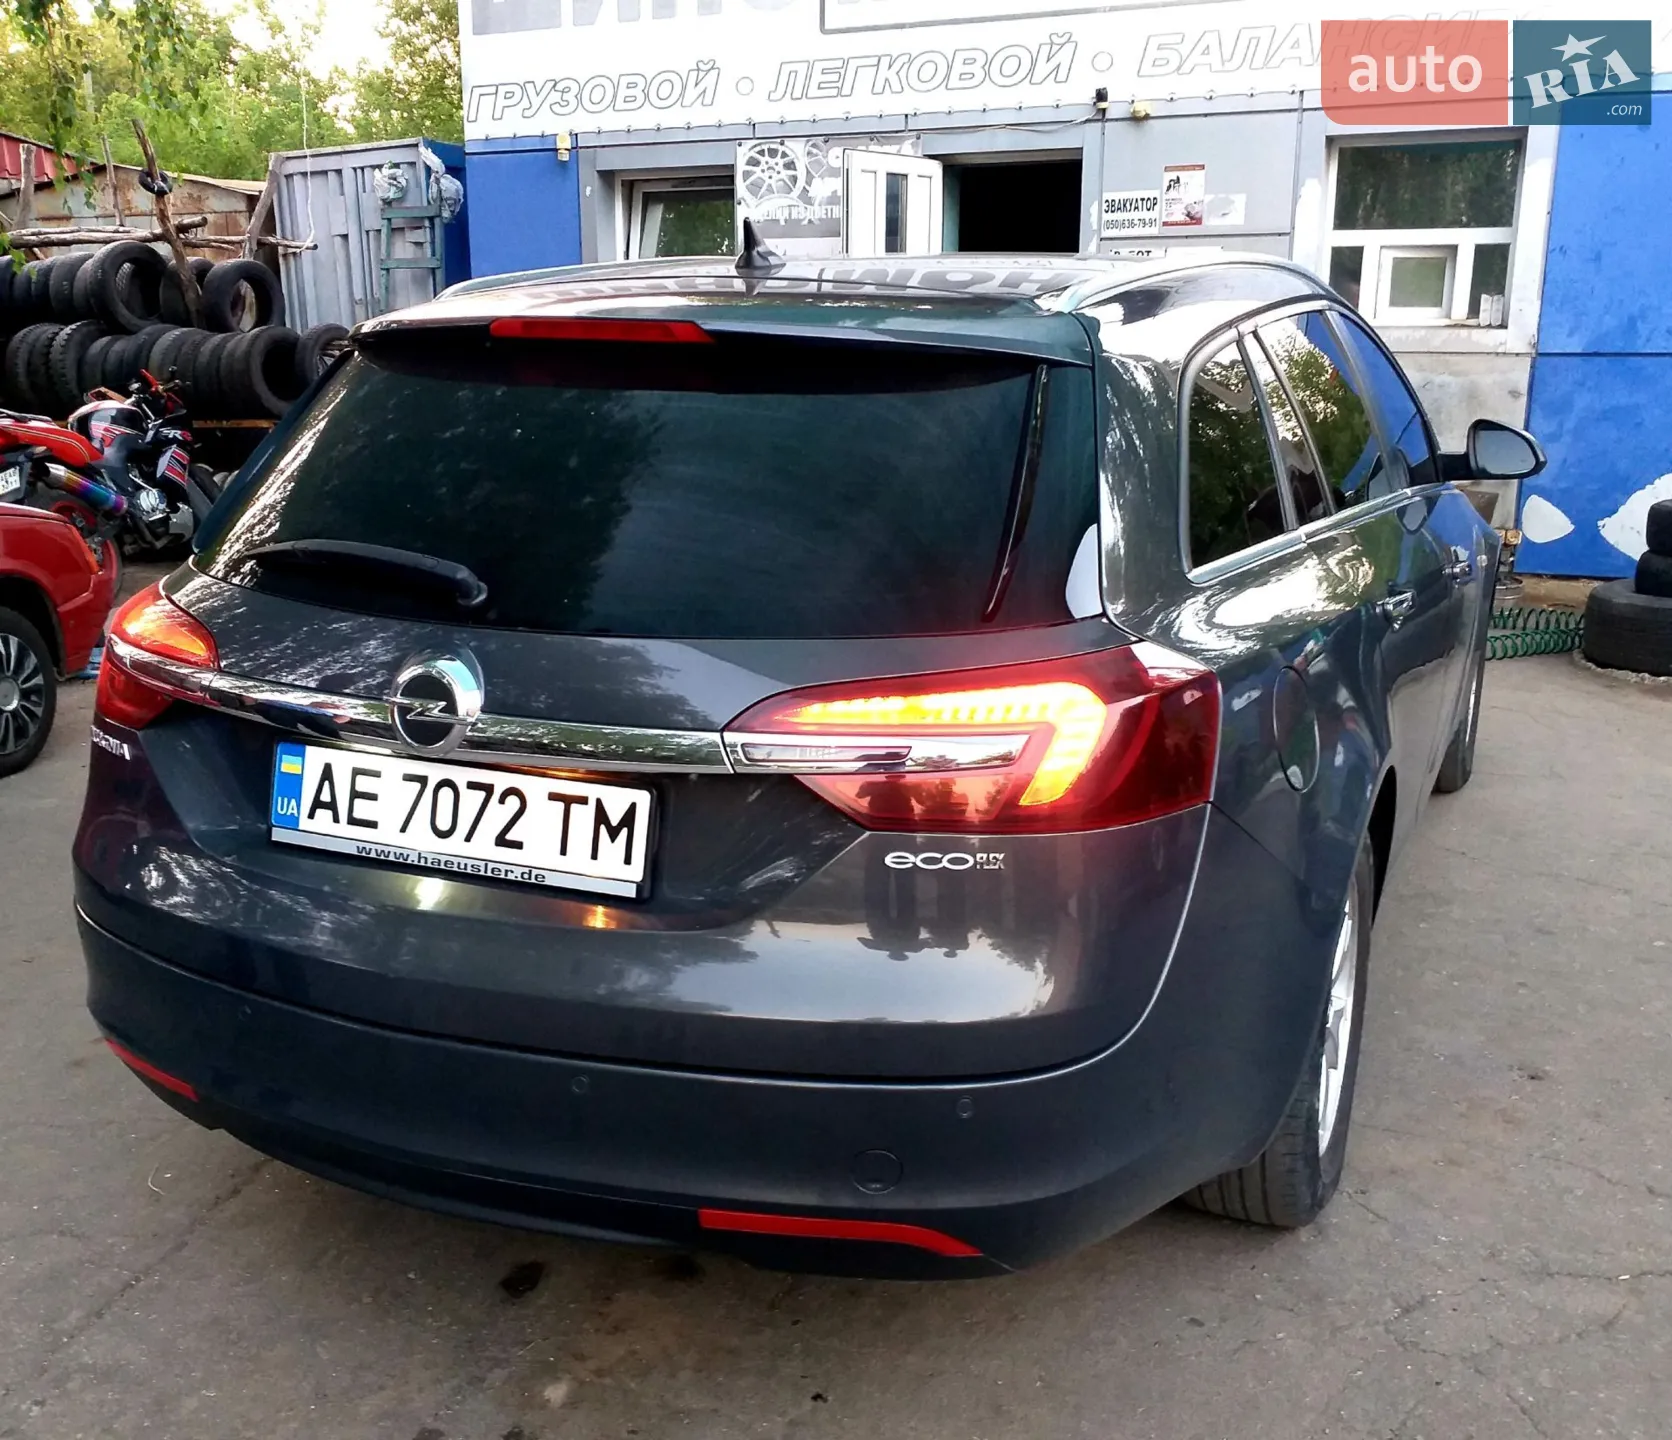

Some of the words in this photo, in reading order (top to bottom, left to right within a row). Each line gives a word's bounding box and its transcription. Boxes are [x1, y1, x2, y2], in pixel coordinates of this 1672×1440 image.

[466, 59, 721, 122] ГРУЗОВОЙ
[768, 32, 1078, 102] ЛЕГКОВОЙ
[1103, 218, 1158, 231] (050)636-79-91
[1104, 197, 1158, 213] ЭВАКУАТОР
[277, 796, 299, 817] UA
[307, 762, 382, 829] AE
[399, 773, 527, 850] 7072
[547, 791, 637, 865] TM
[356, 843, 546, 884] www.haeusler.de
